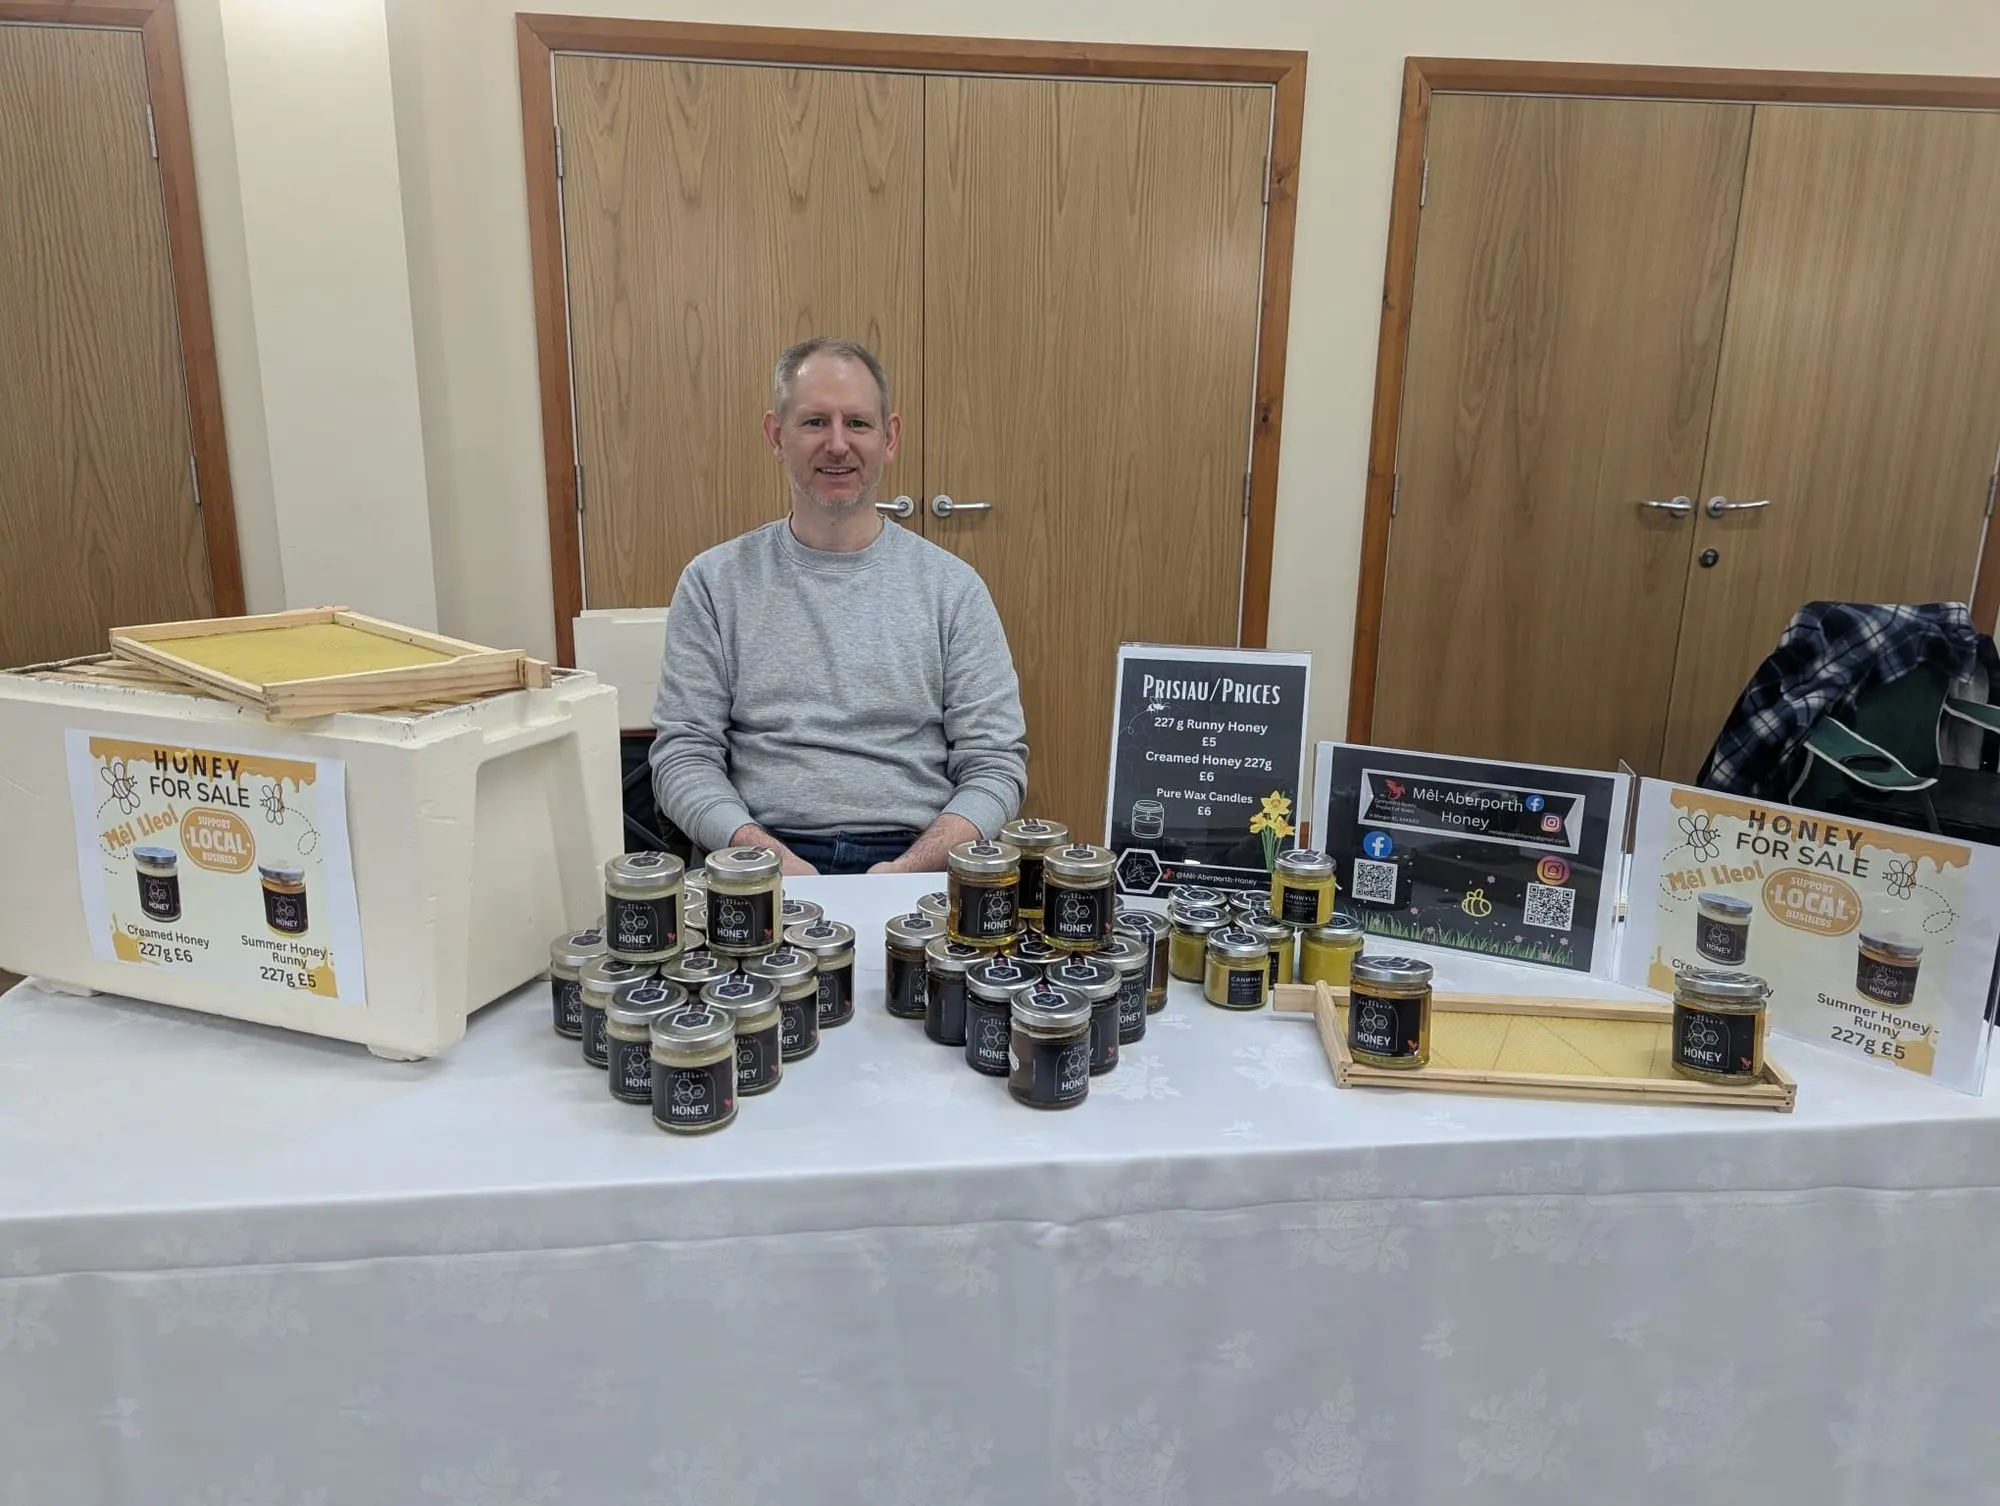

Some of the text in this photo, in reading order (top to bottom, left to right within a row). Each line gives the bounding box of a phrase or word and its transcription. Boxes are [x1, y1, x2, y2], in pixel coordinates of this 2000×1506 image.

[1154, 717, 1268, 736] 227 g Runny Honey
[1202, 737, 1217, 747] £5
[154, 750, 241, 781] HONEY
[1145, 751, 1273, 771] Creamed Honey 227g
[1199, 771, 1215, 782] £6
[149, 776, 251, 809] FOR SALE
[1156, 788, 1253, 804] Pure Wax Candles
[1412, 786, 1524, 813] Mêl-Aberporth
[1197, 806, 1212, 817] £6
[104, 803, 179, 851] Mêl Lleol
[197, 815, 230, 829] SUPPORT
[1441, 811, 1490, 831] Honey
[1748, 809, 1865, 851] HONEY
[189, 826, 247, 856] LOCAL
[202, 852, 238, 866] BUSINESS
[1736, 832, 1870, 879] FOR SALE
[1667, 860, 1765, 892] Mêl Lleol
[1790, 875, 1834, 895] SUPPORT
[148, 900, 171, 912] HONEY
[1774, 884, 1848, 921] LOCAL
[275, 917, 298, 929] HONEY
[983, 918, 1013, 930] HONEY
[1785, 908, 1833, 929] BUSINESS
[717, 927, 749, 939] HONEY
[1060, 922, 1093, 933] HONEY
[127, 924, 211, 949] Creamed Honey
[619, 933, 652, 944] HONEY
[139, 942, 193, 963] 227g £6
[241, 935, 288, 952] Summer
[290, 943, 327, 960] Honey
[1705, 942, 1732, 955] HONEY
[272, 953, 307, 970] Runny
[260, 966, 317, 988] 227g £5
[1868, 985, 1899, 999] HONEY
[1120, 1011, 1141, 1024] ONEY
[1817, 992, 1878, 1020] Summer
[1880, 1010, 1931, 1036] Honey
[1853, 1015, 1901, 1039] Runny
[781, 1034, 800, 1045] NEY
[1357, 1031, 1391, 1047] HONEY
[1830, 1026, 1906, 1061] 227g £5
[1684, 1046, 1722, 1062] HONEY
[737, 1068, 757, 1079] NEY
[625, 1076, 652, 1088] HONE
[1061, 1076, 1088, 1091] HONEY
[672, 1103, 709, 1116] HONEY
